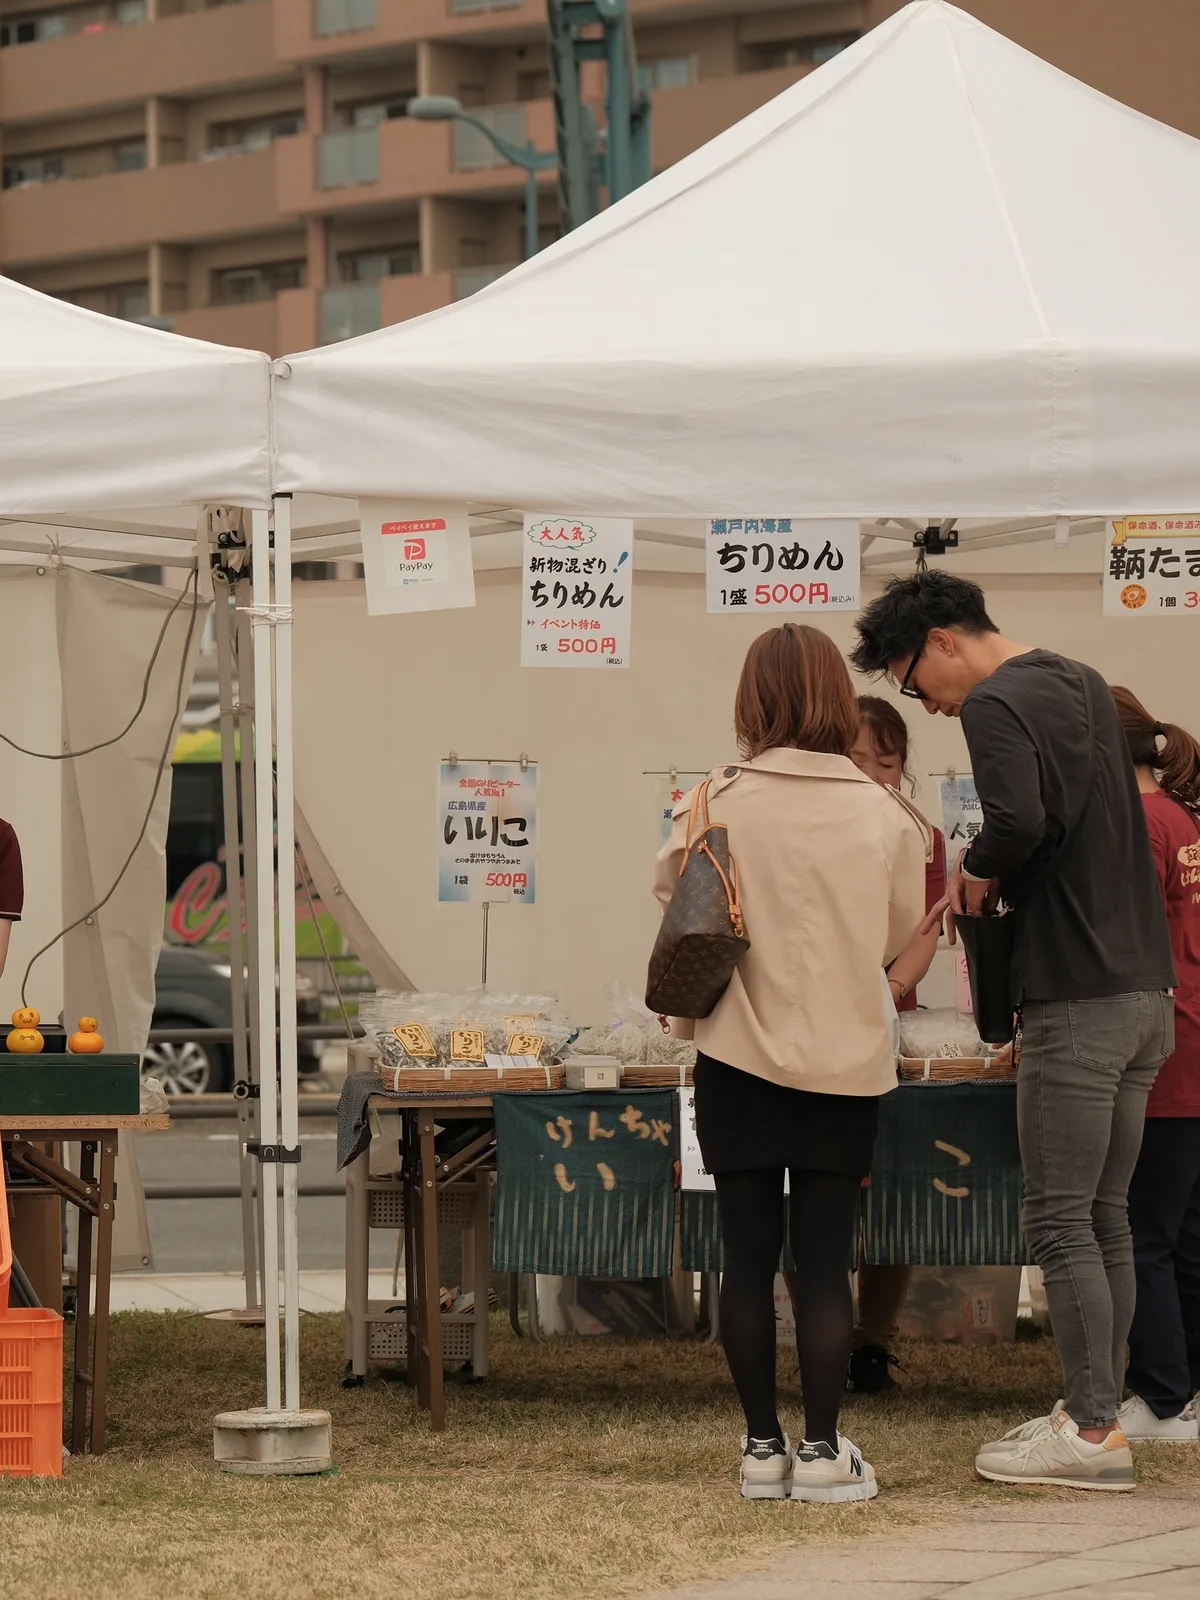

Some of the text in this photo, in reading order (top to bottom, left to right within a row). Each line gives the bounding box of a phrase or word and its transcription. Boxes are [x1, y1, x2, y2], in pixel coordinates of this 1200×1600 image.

[389, 522, 437, 531] ペイペイ使えます
[539, 526, 585, 541] 大人気
[711, 518, 792, 535] 瀬戸内海産
[716, 540, 844, 573] ちりめん
[399, 562, 433, 572] PayPay
[530, 580, 624, 608] ちりめん
[720, 588, 748, 606] 1盛
[754, 582, 829, 605] 500円
[1159, 596, 1176, 607] 1個
[540, 619, 601, 630] イベント特価
[557, 637, 616, 654] 500円
[459, 779, 521, 788] 全国のリピーター
[448, 801, 486, 811] 広島県産
[444, 815, 529, 847] いりこ
[454, 873, 527, 888] 1袋 500円
[400, 1028, 424, 1050] いりこ
[458, 1031, 474, 1054] いりこ
